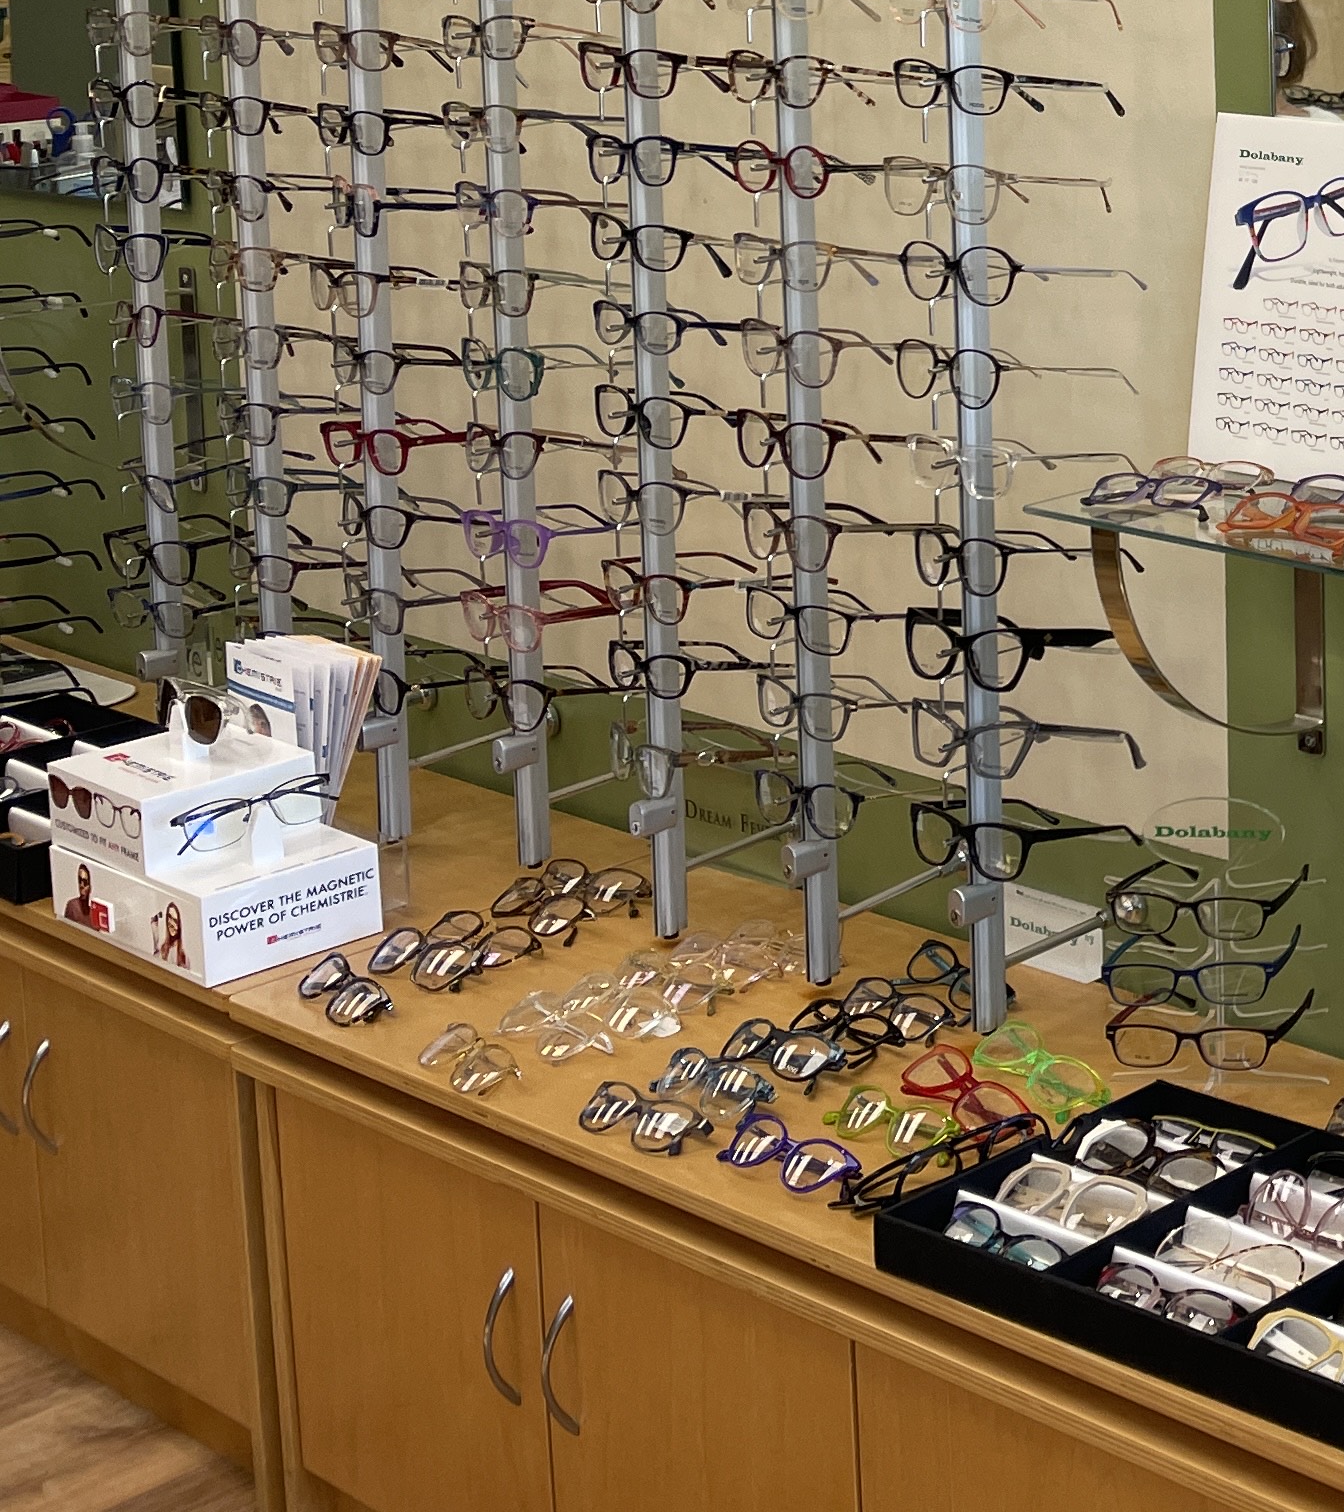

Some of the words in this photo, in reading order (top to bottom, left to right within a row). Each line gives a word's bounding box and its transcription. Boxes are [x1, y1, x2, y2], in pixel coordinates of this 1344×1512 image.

[1239, 148, 1304, 166] Dolabany
[685, 799, 732, 830] DREAM
[1154, 825, 1272, 842] Dolabany
[208, 899, 274, 929] DISCOVER
[279, 890, 302, 907] THE
[306, 867, 375, 899] MAGNETIC
[216, 917, 265, 941] POWER
[268, 909, 287, 924] OF
[290, 884, 367, 918] CHEMISTRIE
[1010, 916, 1078, 946] Dolaby
